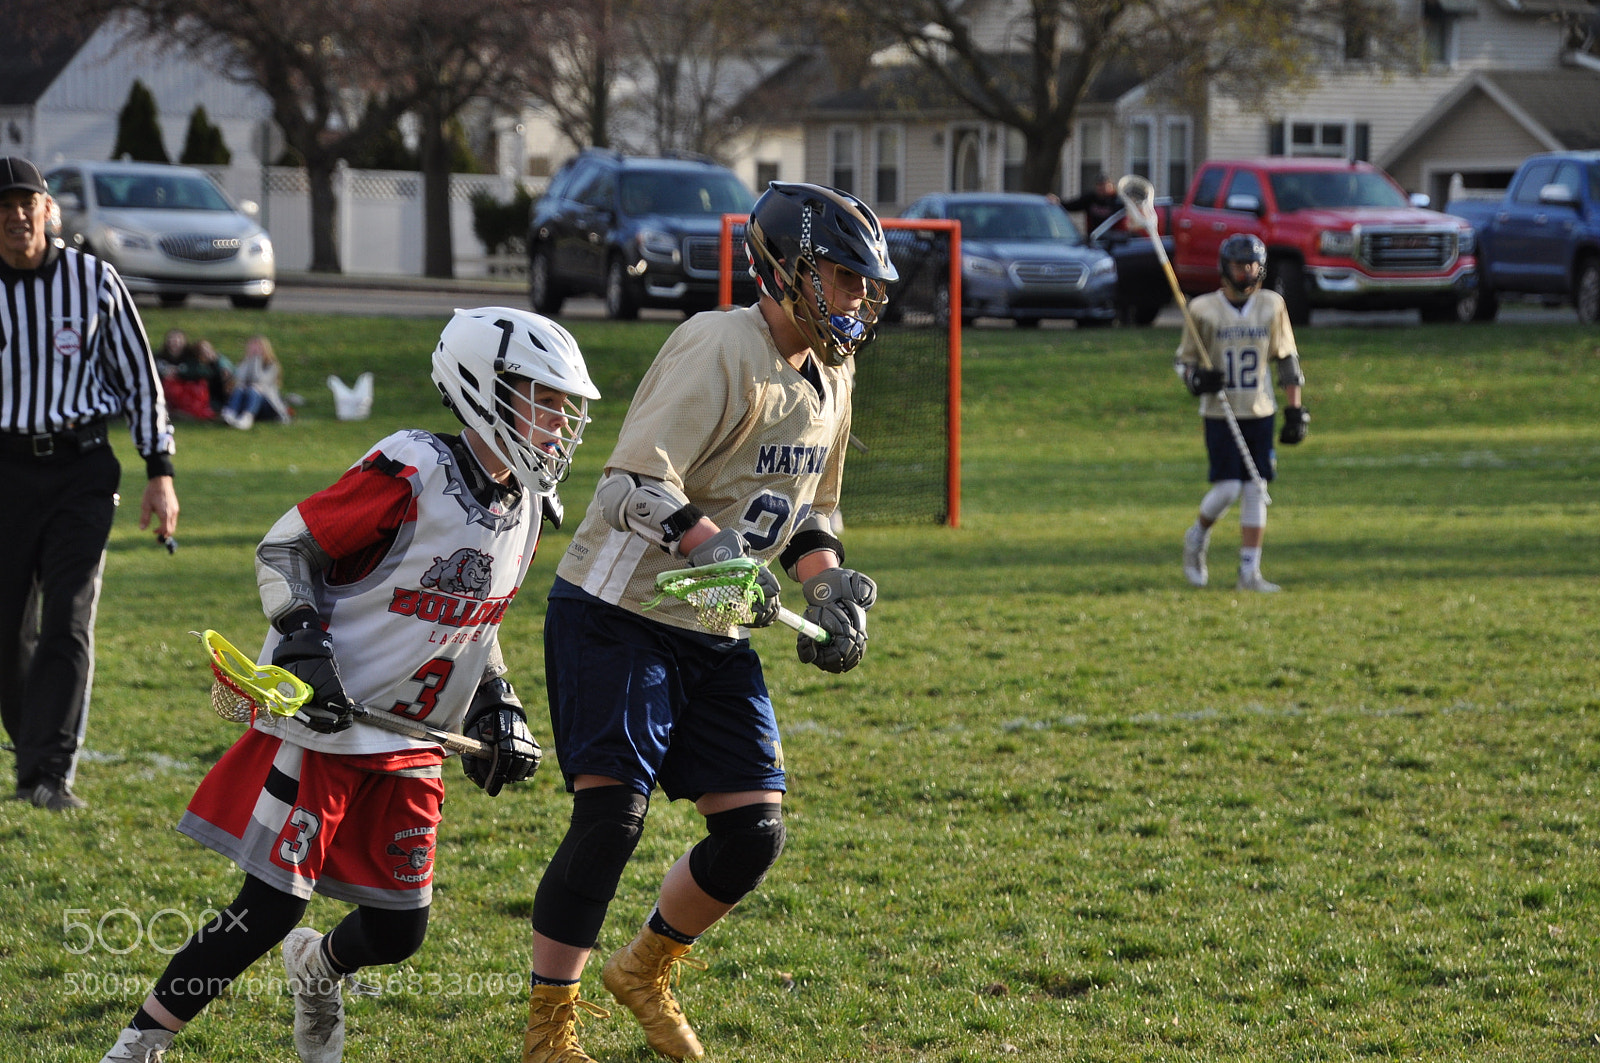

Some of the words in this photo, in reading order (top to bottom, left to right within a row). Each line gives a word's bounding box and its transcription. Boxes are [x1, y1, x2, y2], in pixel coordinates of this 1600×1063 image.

[1225, 349, 1258, 389] 12
[740, 490, 812, 551] 2
[388, 656, 455, 720] 3
[279, 807, 321, 865] 3
